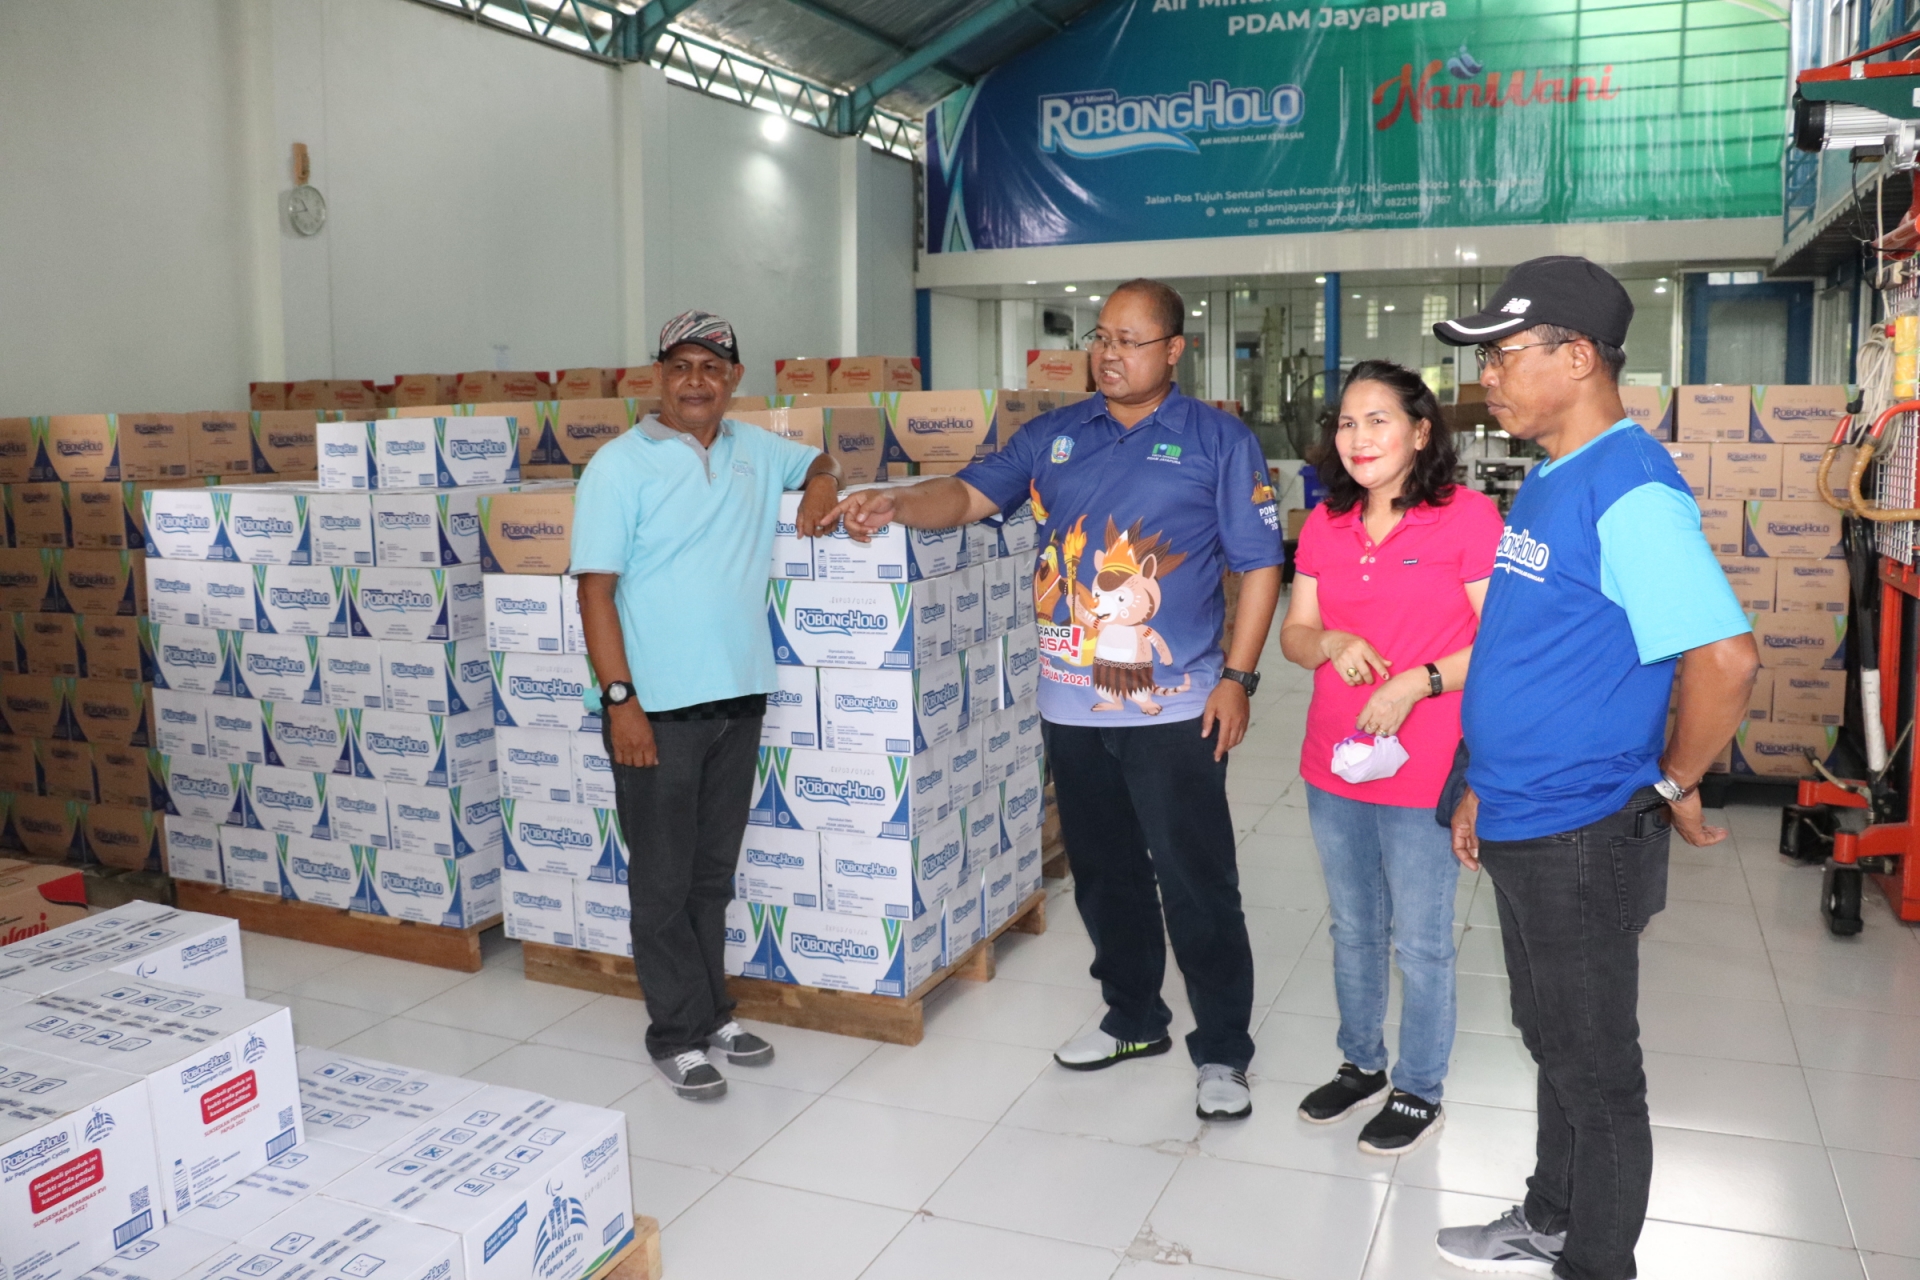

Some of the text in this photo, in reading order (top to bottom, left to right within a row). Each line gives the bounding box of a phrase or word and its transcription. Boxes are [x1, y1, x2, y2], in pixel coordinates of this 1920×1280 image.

[1228, 1, 1446, 36] PDAM Jayapura
[1039, 80, 1305, 156] ROBONGHOLO
[1145, 195, 1172, 205] Jalan
[1174, 193, 1192, 203] Pos
[1194, 192, 1223, 203] Tujuh
[1225, 189, 1265, 200] Sentani
[1267, 188, 1296, 198] Sereh
[1299, 186, 1351, 198] Kampung
[1223, 205, 1252, 215] www.
[908, 416, 973, 435] ROBONGHOLO
[451, 439, 507, 460] ROBONGHOLO
[379, 512, 431, 531] ROBONGHOLO
[1259, 505, 1275, 517] PON
[1264, 516, 1278, 526] PAP
[156, 513, 210, 534] ROBONGHOLO
[234, 516, 294, 538] ROBONGHOLO
[320, 515, 361, 531] ROBONGHOLO
[502, 522, 564, 543] ROBONGHOLO
[1768, 522, 1829, 537] ROBONGHOLO
[270, 587, 331, 611] ROBONGHOLO
[361, 588, 432, 614] ROBONGHOLO
[496, 598, 547, 615] ROBONGHOLO
[795, 608, 888, 636] ROBONGHOLO
[1764, 635, 1824, 648] ROBONGHOLO
[164, 646, 216, 668] ROBONGHOLO
[247, 653, 305, 677] ROBONGHOLO
[509, 676, 584, 702] ROBONGHOLO
[1062, 673, 1091, 686] 2021
[835, 694, 898, 714] ROBONGHOLO
[275, 722, 337, 747] ROBONGHOLO
[366, 732, 429, 757] ROBONGHOLO
[509, 749, 559, 766] ROBONGHOLO
[171, 773, 228, 798] ROBONGHOLO
[795, 775, 885, 806] ROBONGHOLO
[256, 786, 313, 811] ROBONGHOLO
[520, 823, 593, 850] ROBONGHOLO
[292, 857, 350, 882] ROBONGHOLO
[747, 849, 805, 869] ROBONGHOLO
[835, 859, 897, 879] ROBONGHOLO
[381, 871, 444, 897] ROBONGHOLO
[513, 892, 562, 910] ROBONGHOLO
[791, 932, 879, 963] ROBONGHOLO
[1392, 1101, 1428, 1120] NIKE
[1, 1131, 69, 1173] ROBONGHOLO
[4, 1175, 13, 1184] Air
[14, 1157, 51, 1178] Pegunungan
[34, 1154, 98, 1191] Membeli produk ini
[38, 1163, 96, 1198] bukti anda peduli
[41, 1174, 96, 1205] kaum disabilitas
[33, 1207, 68, 1228] SUKSESKAN
[68, 1191, 97, 1210] PEPARNAS
[54, 1209, 75, 1224] PAPUA
[539, 1236, 572, 1277] PEPARNAS
[572, 1232, 584, 1243] XVI
[545, 1258, 564, 1279] PAPUA
